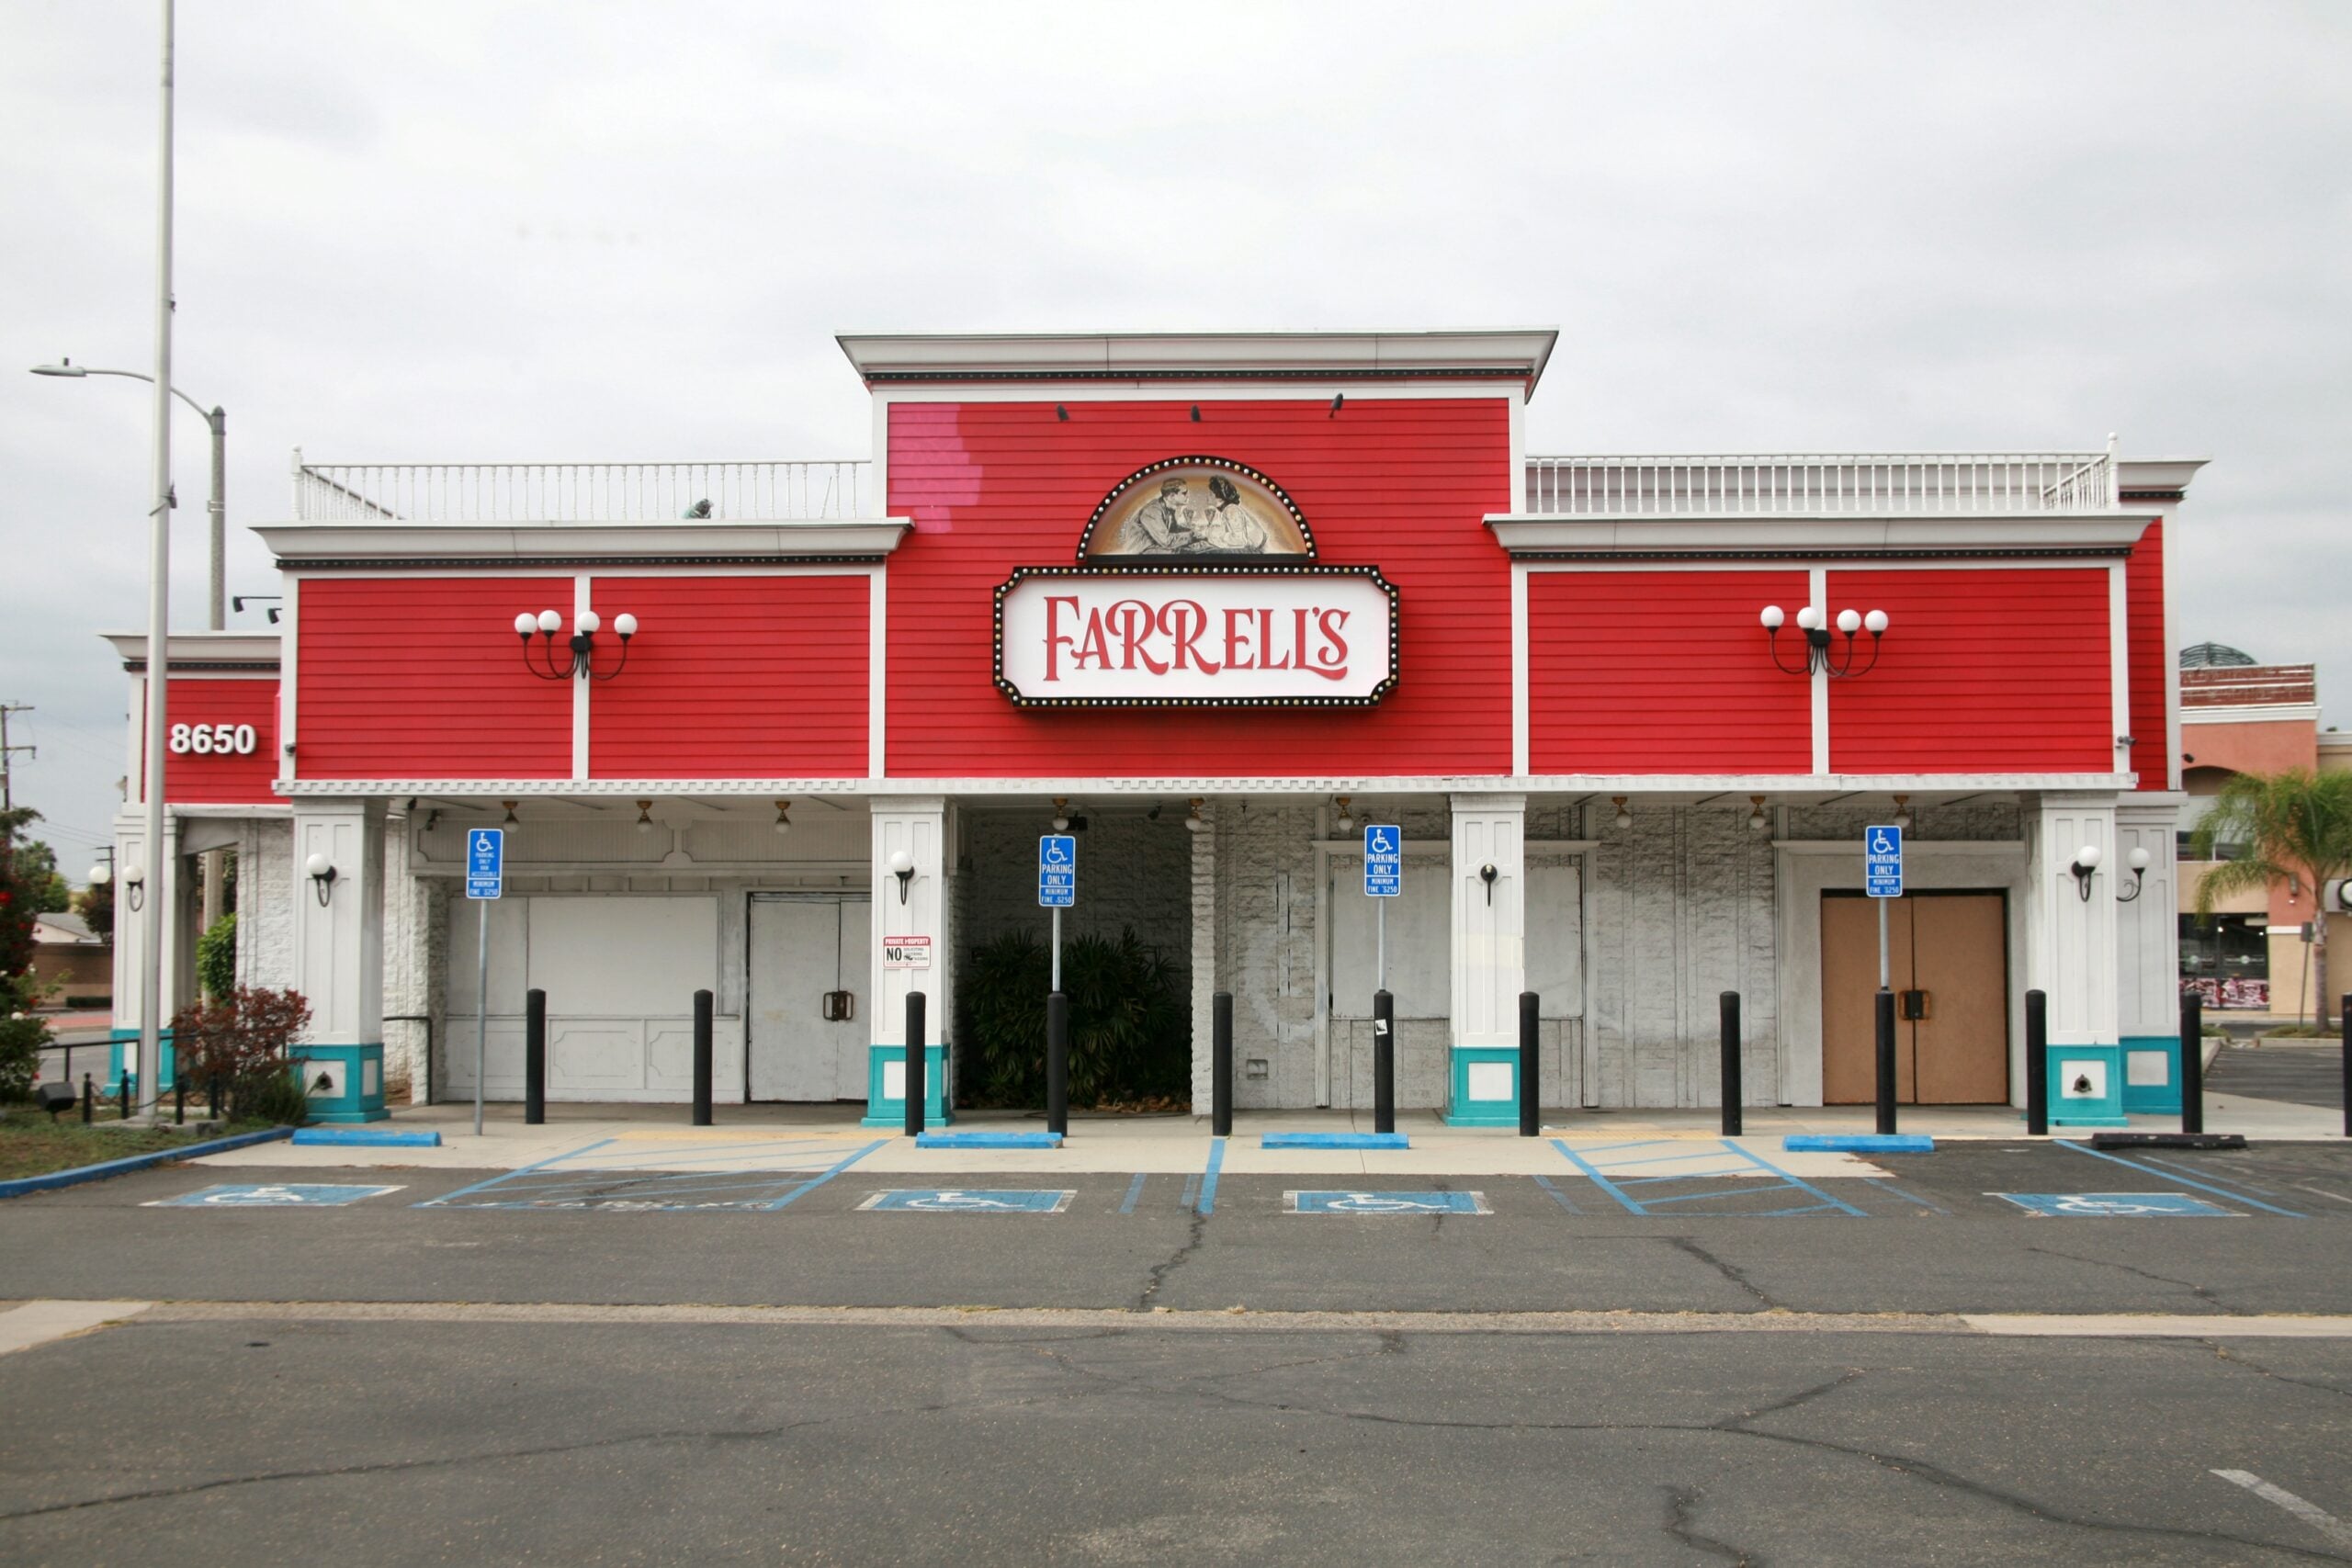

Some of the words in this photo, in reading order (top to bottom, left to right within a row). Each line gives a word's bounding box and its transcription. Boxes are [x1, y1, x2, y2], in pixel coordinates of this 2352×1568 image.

[1043, 595, 1351, 682] FARRELL'S
[169, 723, 256, 754] 8650
[1367, 853, 1397, 863] PARKING
[1869, 854, 1899, 863] PARKING
[1042, 863, 1072, 874] PARKING
[1374, 864, 1392, 874] ONLY
[1875, 865, 1894, 874] ONLY
[1047, 874, 1066, 885] ONLY
[887, 947, 902, 961] NO
